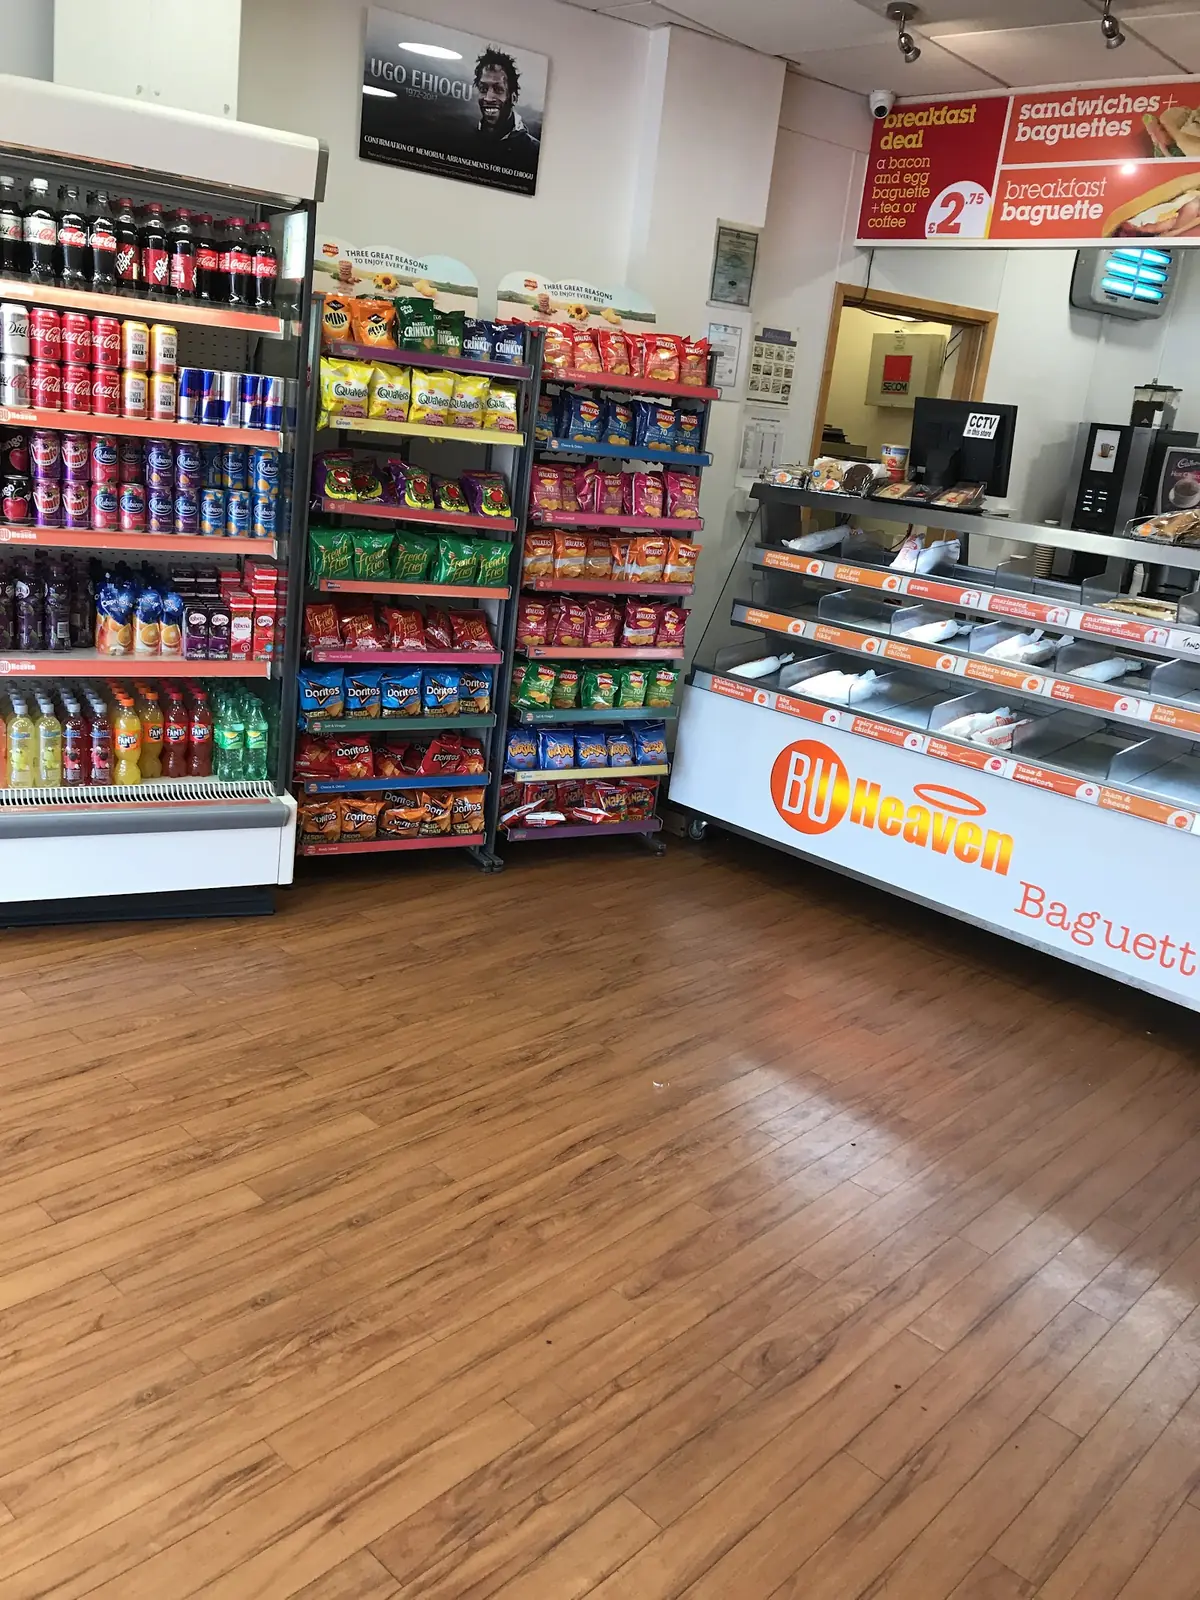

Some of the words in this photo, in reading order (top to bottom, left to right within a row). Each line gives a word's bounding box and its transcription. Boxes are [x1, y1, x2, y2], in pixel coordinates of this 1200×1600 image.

[370, 58, 406, 84] UGO
[411, 69, 473, 101] EHIOGU
[1019, 93, 1161, 121] sandwiches
[882, 103, 977, 129] breakfast
[1015, 118, 1132, 146] baguettes
[880, 130, 924, 150] deal
[364, 134, 407, 152] CONFIRMATION
[407, 145, 415, 153] OF
[415, 147, 446, 160] MEMORIAL
[446, 154, 490, 171] ARRANGEMENTS
[489, 161, 501, 173] FOR
[501, 166, 513, 176] UGO
[513, 168, 534, 181] EHIOGU
[876, 157, 886, 170] a
[888, 156, 931, 170] bacon
[874, 171, 900, 185] and
[903, 172, 930, 186] egg
[871, 185, 931, 200] baguette
[1004, 177, 1108, 201] breakfast
[903, 201, 917, 213] or
[1000, 200, 1104, 227] baguette
[867, 215, 907, 229] coffee
[345, 250, 369, 259] THREE
[370, 251, 394, 261] GREAT
[395, 255, 429, 271] REASONS
[364, 258, 385, 267] ENJOY
[385, 262, 404, 270] EVERY
[405, 265, 418, 274] BITE
[564, 285, 584, 293] GREAT
[584, 287, 613, 301] REASONS
[576, 293, 592, 301] EVERY
[593, 296, 604, 304] BITE
[8, 321, 27, 338] Diet
[883, 382, 908, 392] SECOM
[969, 414, 997, 430] CCTV
[972, 429, 980, 437] this
[980, 430, 992, 438] store
[909, 584, 929, 593] prawn
[991, 604, 1010, 613] cajun
[1009, 607, 1036, 617] chicken
[1083, 622, 1111, 632] chinese
[1111, 627, 1141, 639] chicken
[967, 669, 994, 680] chicken
[968, 661, 999, 676] southern
[426, 684, 458, 696] Doritos
[460, 677, 490, 689] Doritos
[1055, 683, 1070, 692] egg
[305, 686, 340, 699] Doritos
[348, 686, 380, 698] Doritos
[387, 686, 418, 698] Doritos
[1054, 690, 1075, 700] mayo
[777, 702, 800, 714] chicken
[1156, 706, 1175, 715] ham
[1153, 714, 1176, 725] salad
[854, 725, 879, 737] chicken
[856, 718, 874, 730] spicy
[874, 723, 905, 737] american
[336, 744, 370, 757] Doritos
[433, 754, 460, 762] Doritos
[1015, 772, 1054, 789] sweetcorn
[781, 751, 839, 825] BU
[384, 792, 415, 808] Doritos
[1102, 798, 1131, 810] cheese
[848, 777, 1014, 876] Heaven
